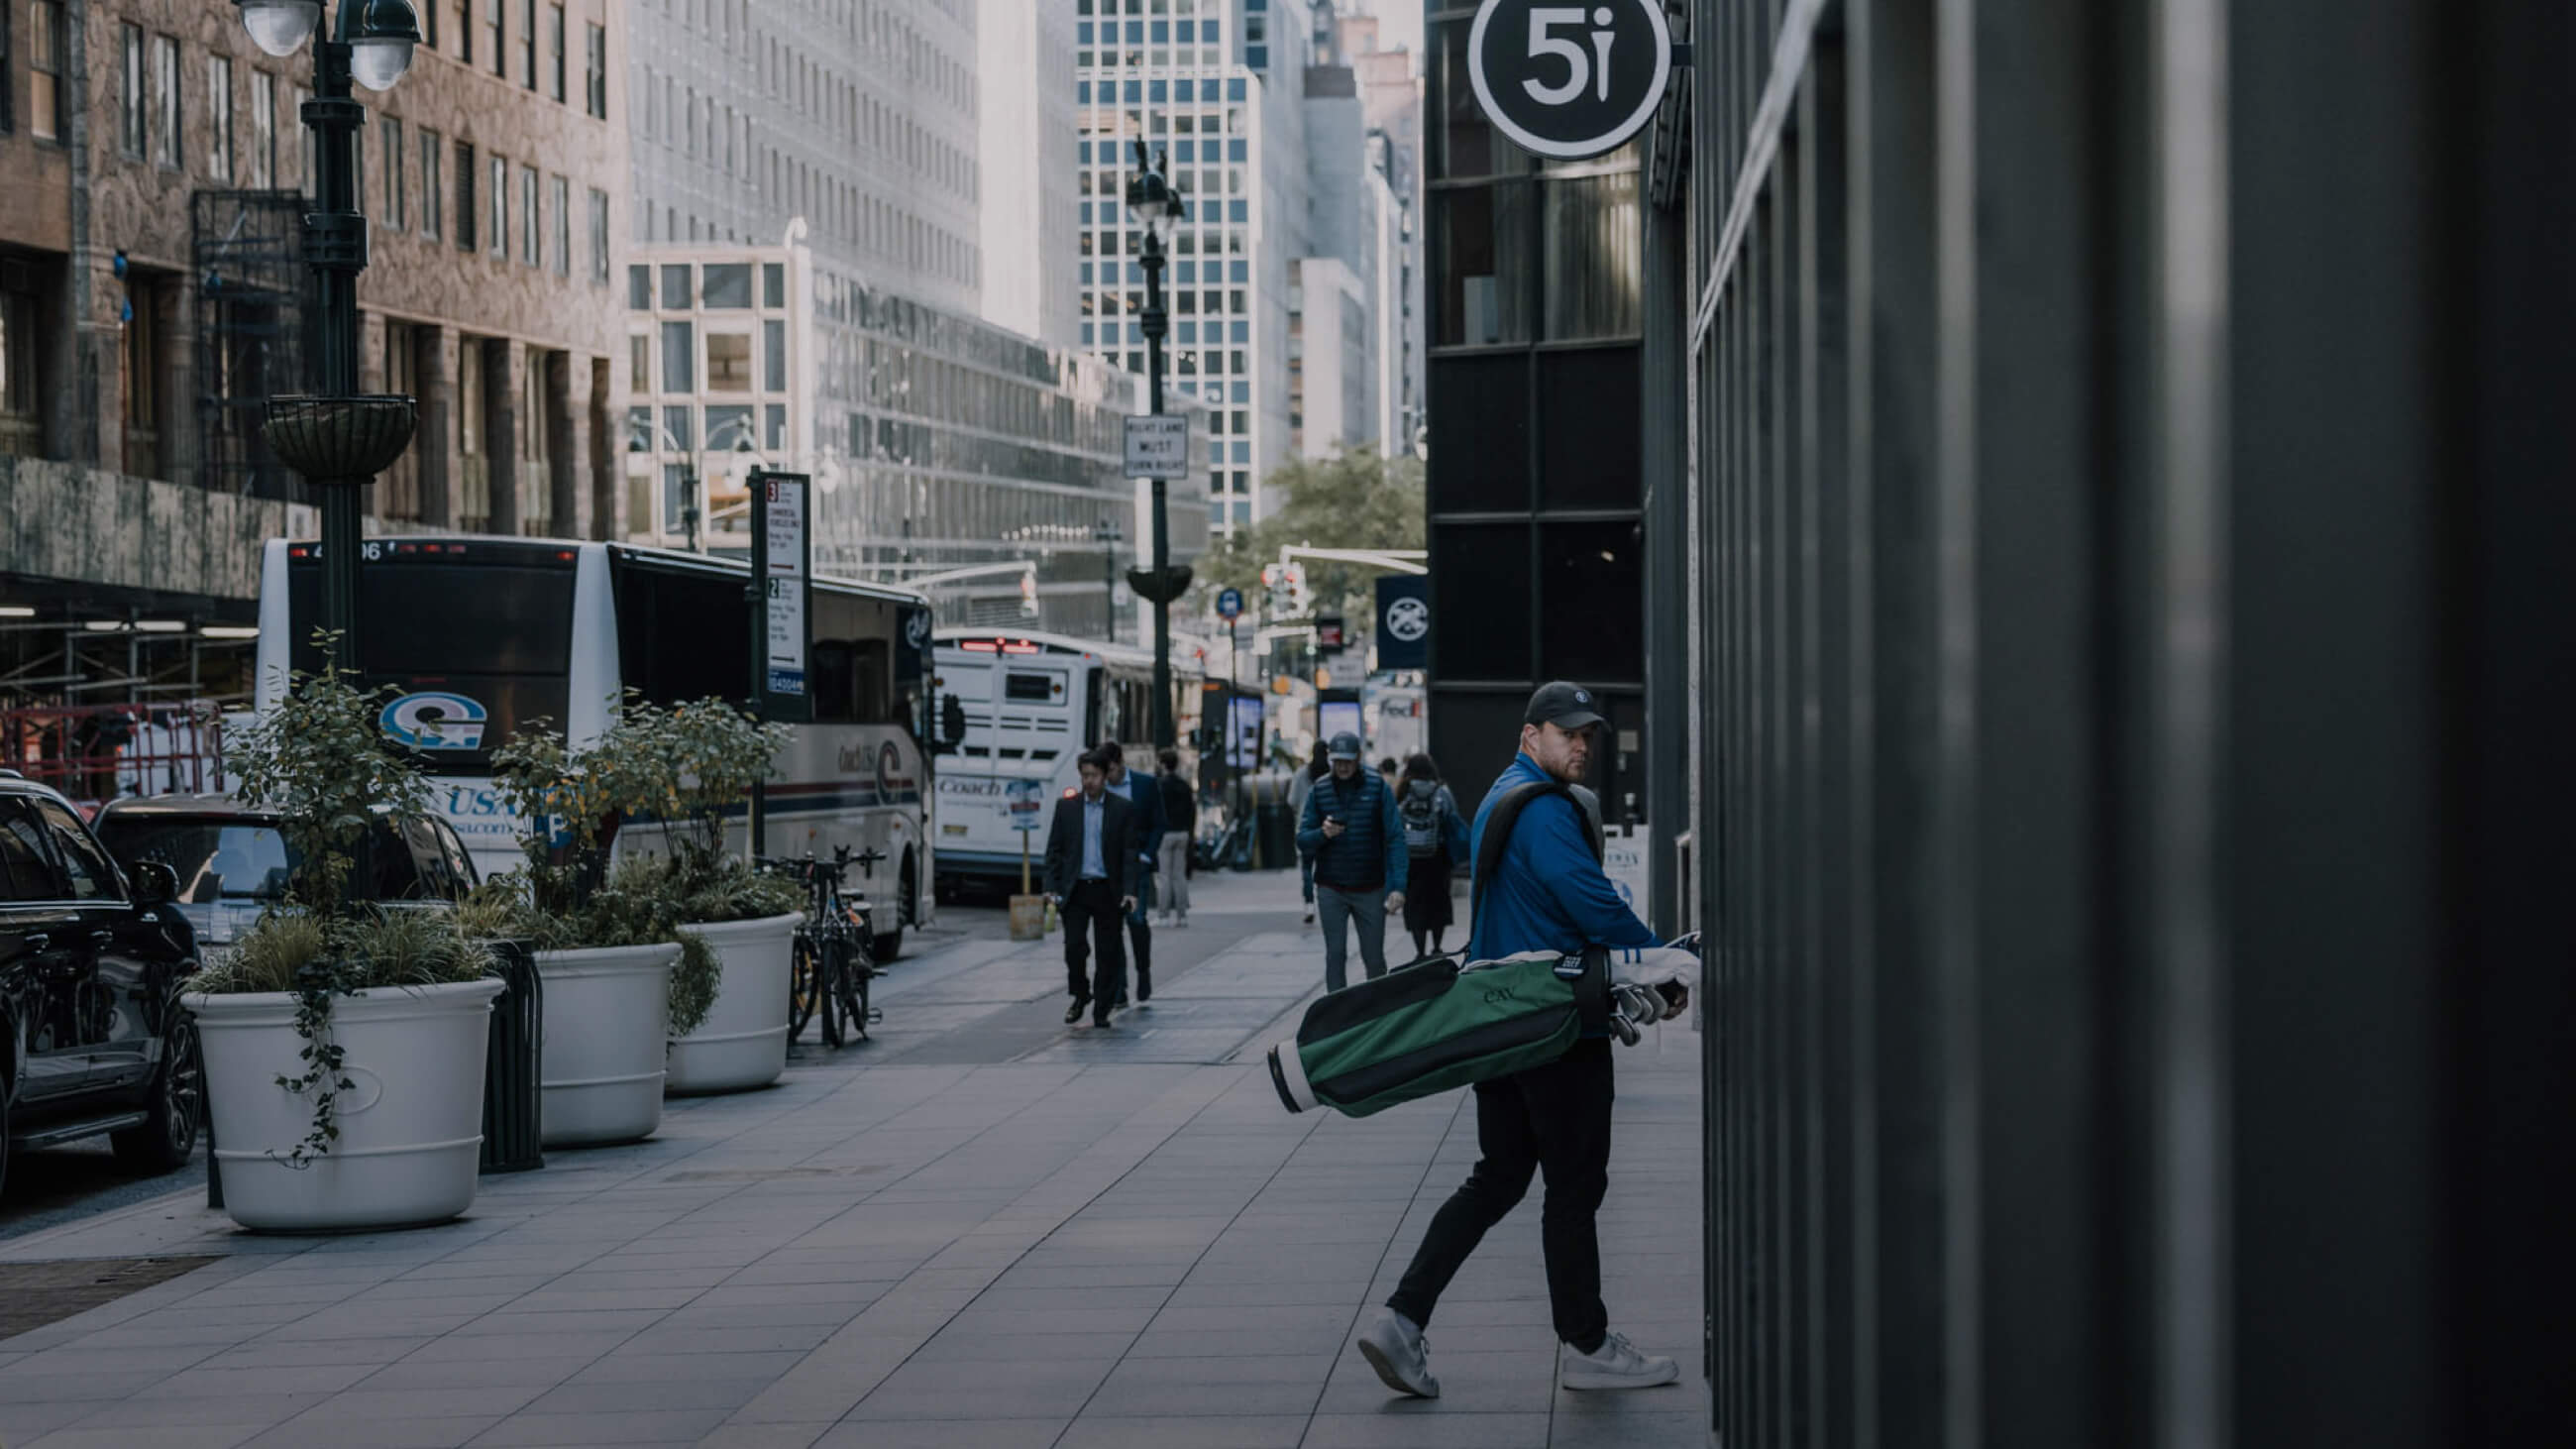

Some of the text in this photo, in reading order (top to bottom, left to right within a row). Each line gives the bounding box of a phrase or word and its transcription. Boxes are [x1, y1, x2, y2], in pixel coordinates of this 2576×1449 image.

[1521, 6, 1616, 106] 5i
[1127, 423, 1183, 433] RIGHT LANE
[1138, 441, 1172, 452] MUST
[1127, 461, 1184, 471] TURN RIGHT
[939, 780, 1001, 797] Coach
[450, 788, 516, 816] USA
